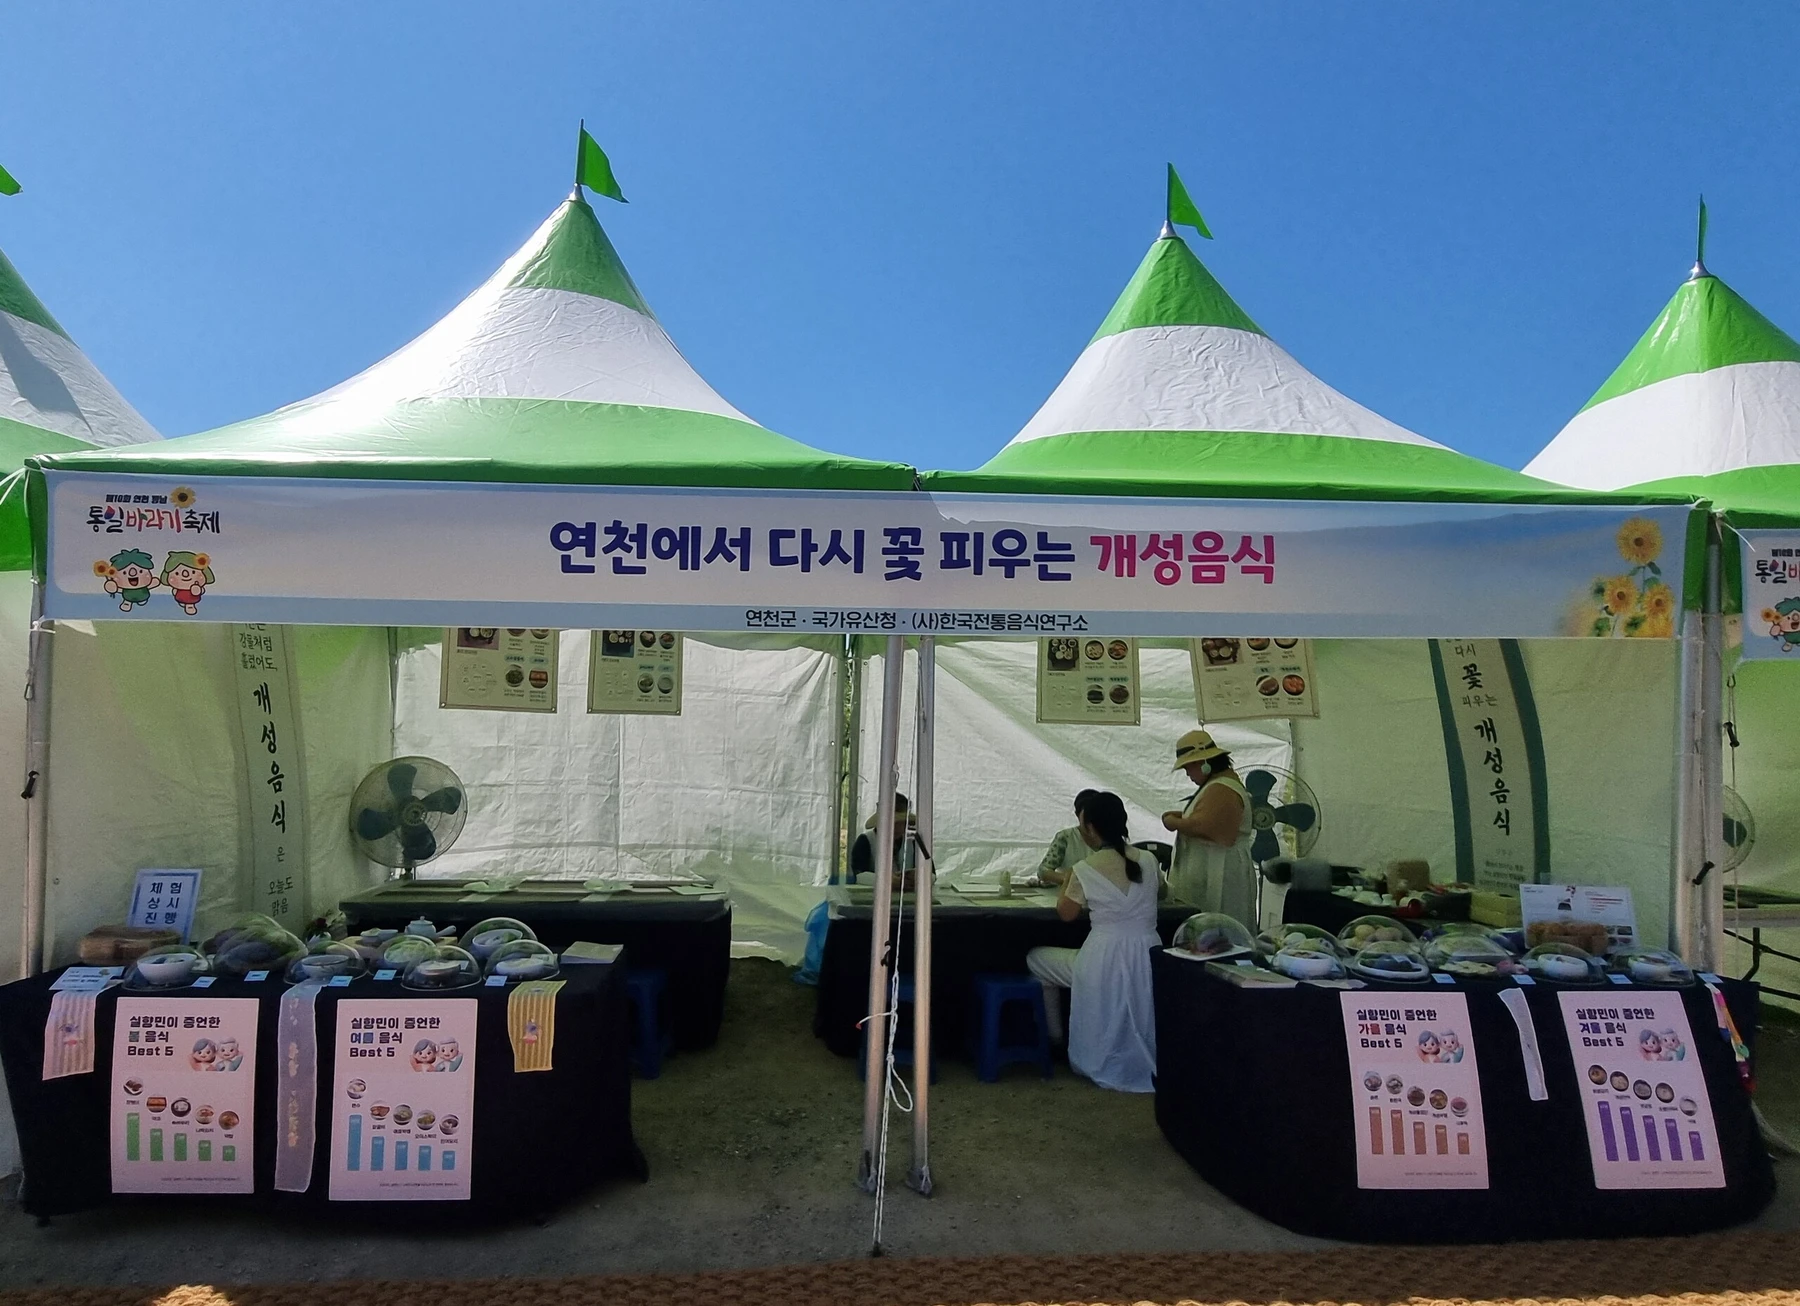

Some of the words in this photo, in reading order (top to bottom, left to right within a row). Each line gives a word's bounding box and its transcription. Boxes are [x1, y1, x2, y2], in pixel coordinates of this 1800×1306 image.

[86, 505, 221, 534] 통일바라기축제
[549, 519, 752, 575] 연천에서
[768, 527, 866, 574] 다시
[881, 526, 925, 582] 꽃
[939, 528, 1076, 582] 피우는
[1089, 530, 1275, 586] 개성음식
[745, 609, 797, 628] 연천군
[811, 610, 896, 629] 국가유산청
[911, 611, 1088, 632] (사)한국전통음식연구소
[1454, 643, 1477, 658] 다시
[1462, 663, 1484, 690] 꽃
[1462, 693, 1499, 708] 피우는
[253, 681, 286, 834] 개성음식
[1473, 716, 1511, 836] 개성음식
[267, 876, 294, 896] 오늘도
[129, 1016, 178, 1029] 실향민이
[183, 1016, 221, 1029] 증언한
[351, 1017, 399, 1029] 실향민이
[404, 1017, 441, 1029] 증언한
[1358, 1023, 1381, 1035] 가을
[1384, 1023, 1407, 1035] 음식
[1604, 1022, 1627, 1034] 음식
[145, 1030, 169, 1043] 음식
[379, 1032, 403, 1044] 음식
[1360, 1038, 1391, 1048] Best
[1394, 1038, 1403, 1048] 5
[1582, 1037, 1613, 1047] Best
[1615, 1037, 1625, 1047] 5
[127, 1045, 161, 1056] Best
[164, 1045, 174, 1056] 5
[349, 1047, 382, 1057] Best
[386, 1047, 395, 1057] 5
